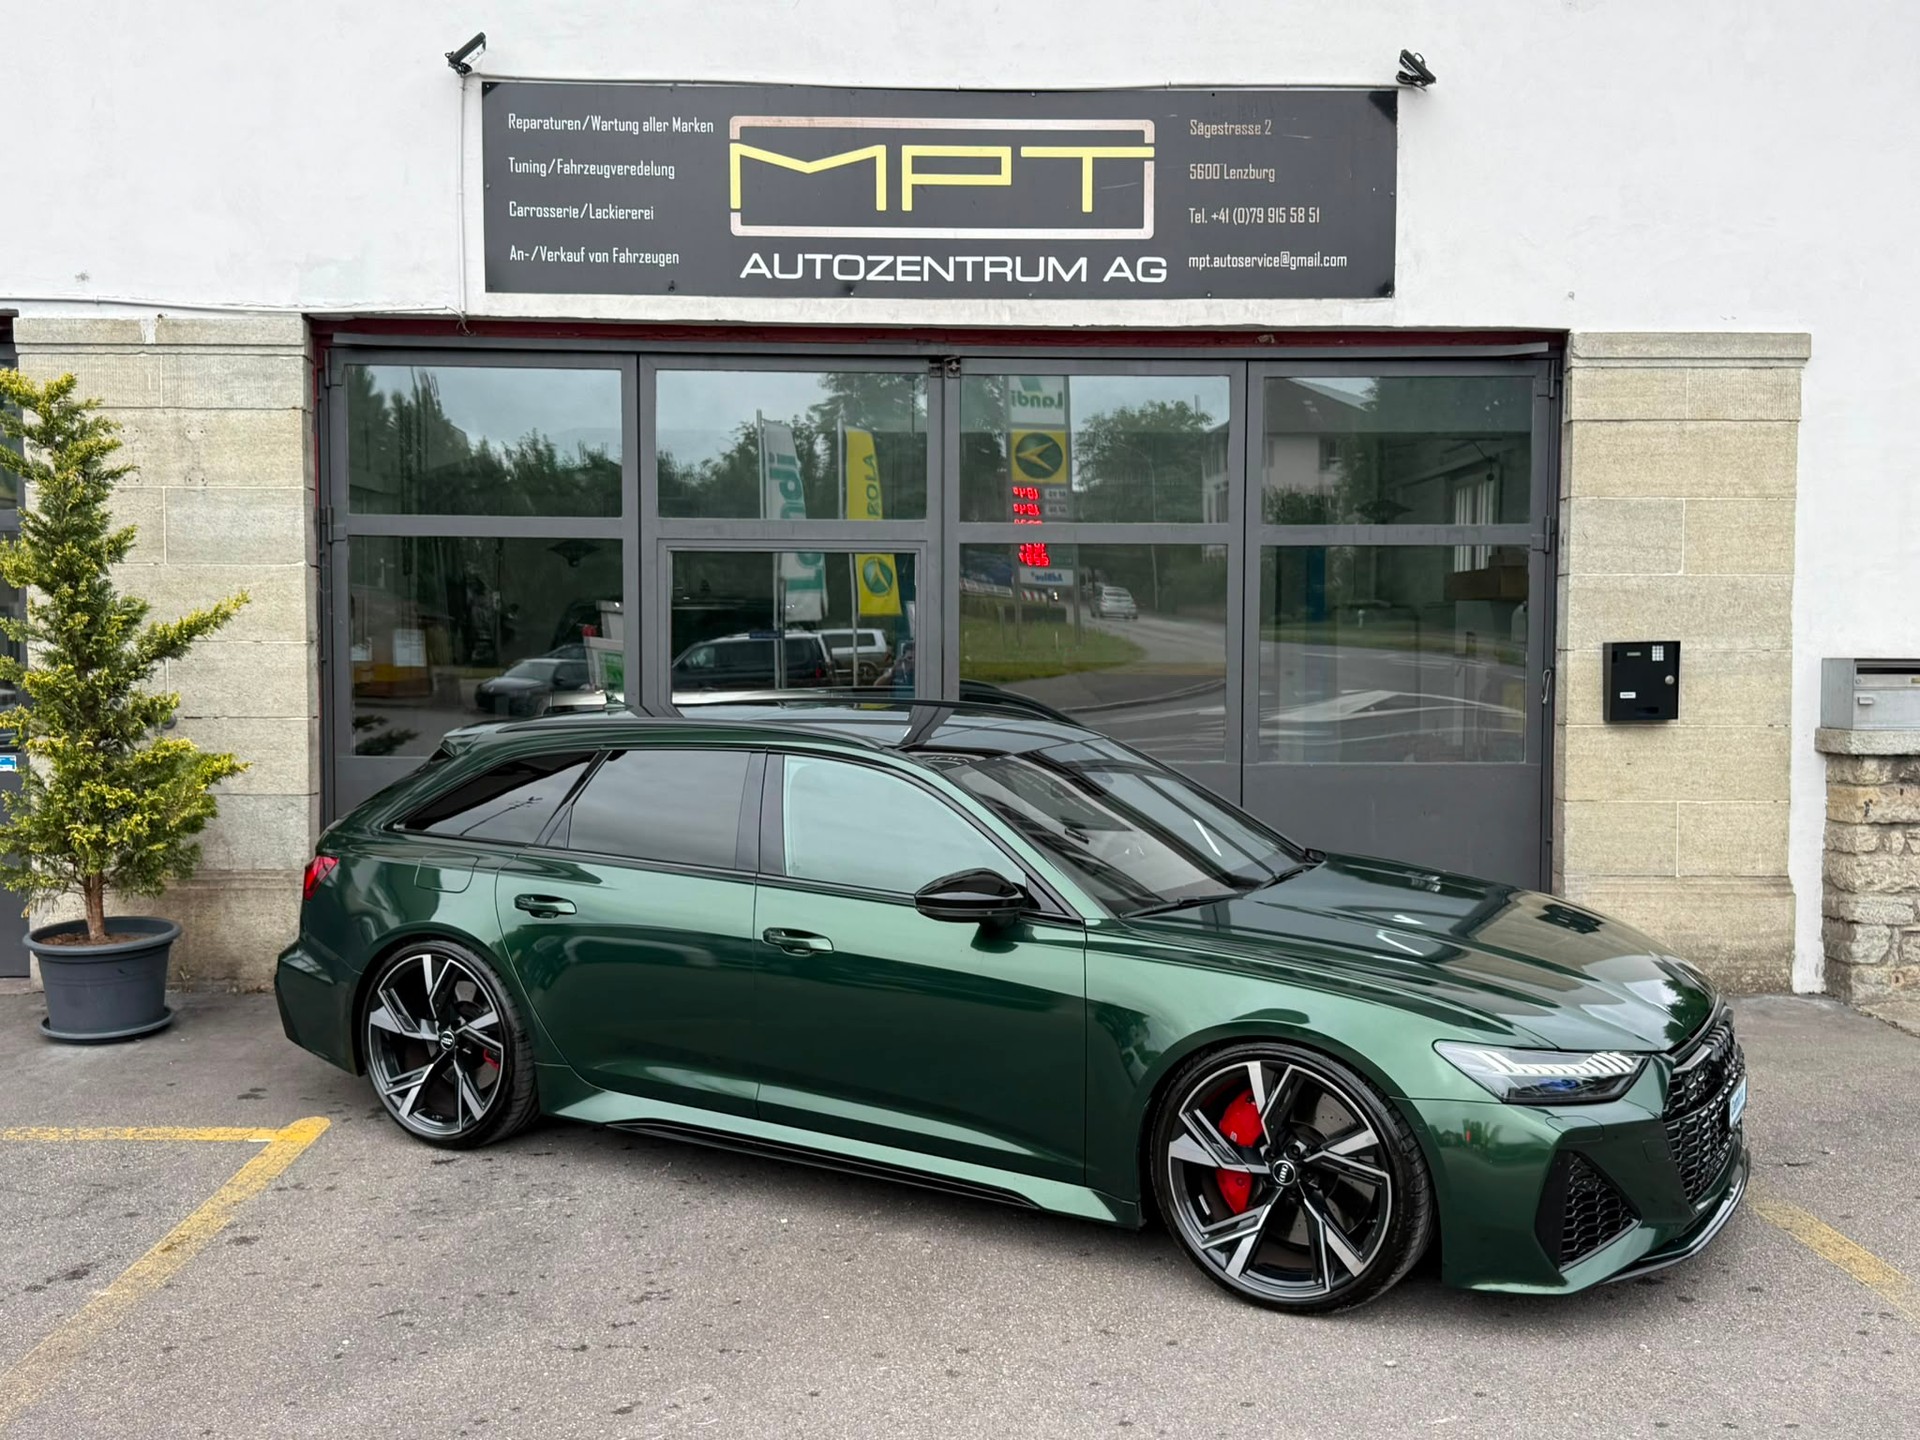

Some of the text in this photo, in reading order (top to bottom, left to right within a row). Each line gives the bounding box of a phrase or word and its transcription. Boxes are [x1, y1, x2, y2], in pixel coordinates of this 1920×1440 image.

[508, 113, 714, 135] Reparaturen/Wartung aller Marken
[1190, 119, 1272, 138] Sägestrasse 2
[508, 157, 676, 179] Tuning/Fahrzeugveredelung
[730, 143, 1155, 213] MPT
[1189, 163, 1276, 183] 5600 Lenzburg
[509, 201, 654, 221] Carrosserie/Lackiererei
[1189, 207, 1320, 226] Tel. +41 (0)79 915 58 51
[509, 245, 680, 267] An-/Verkauf von Fahrzeugen
[1188, 251, 1348, 270] mpt.autoservice@gmail.com
[740, 253, 1168, 283] AUTOZENTRUM AG
[863, 453, 881, 517] ROLA
